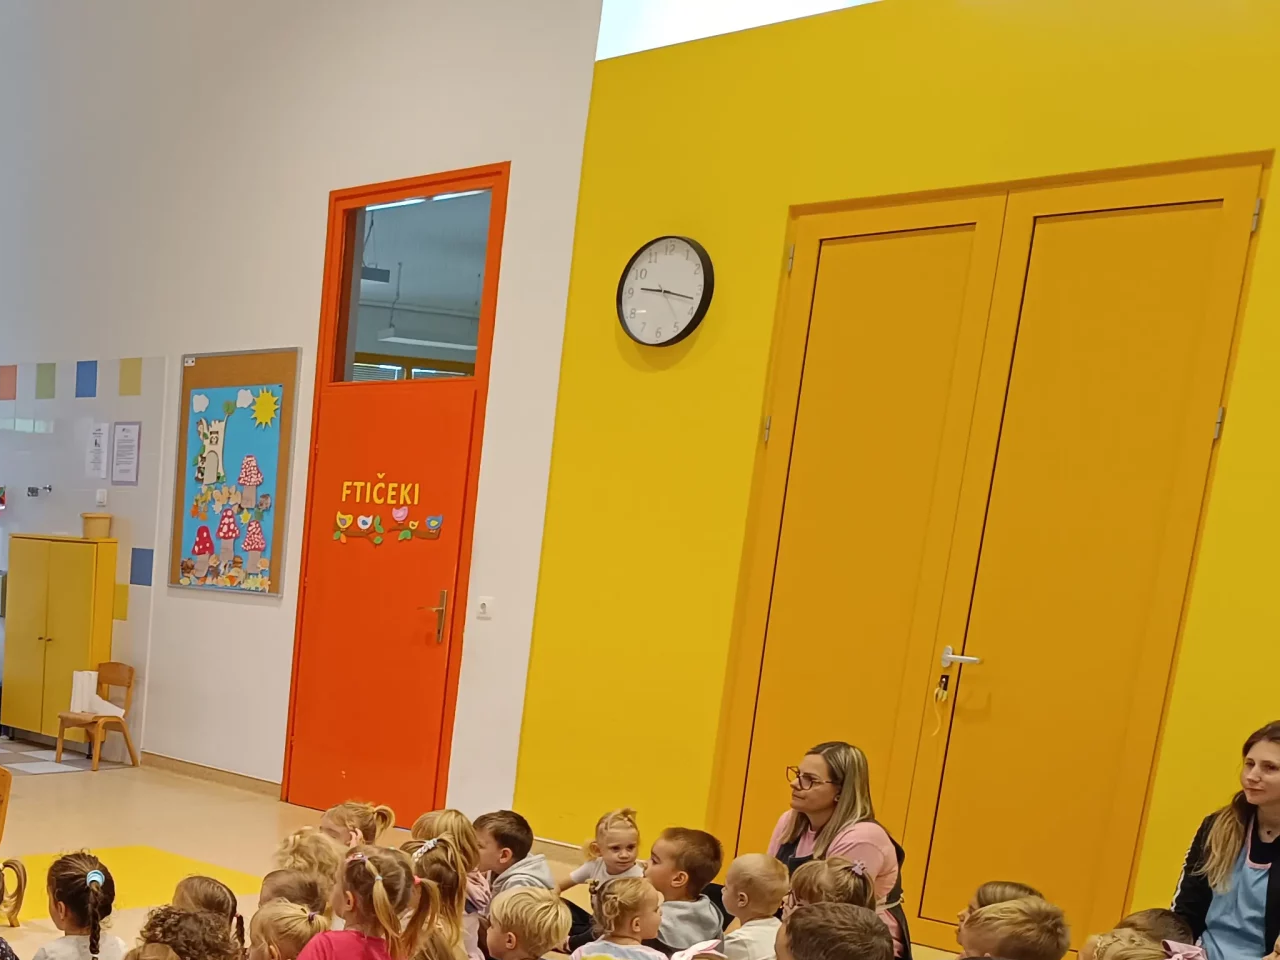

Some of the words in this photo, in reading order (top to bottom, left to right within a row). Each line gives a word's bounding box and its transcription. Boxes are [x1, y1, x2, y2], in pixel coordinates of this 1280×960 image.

[664, 244, 676, 256] 12
[635, 268, 648, 281] 10
[341, 472, 420, 505] FTIČEKI
